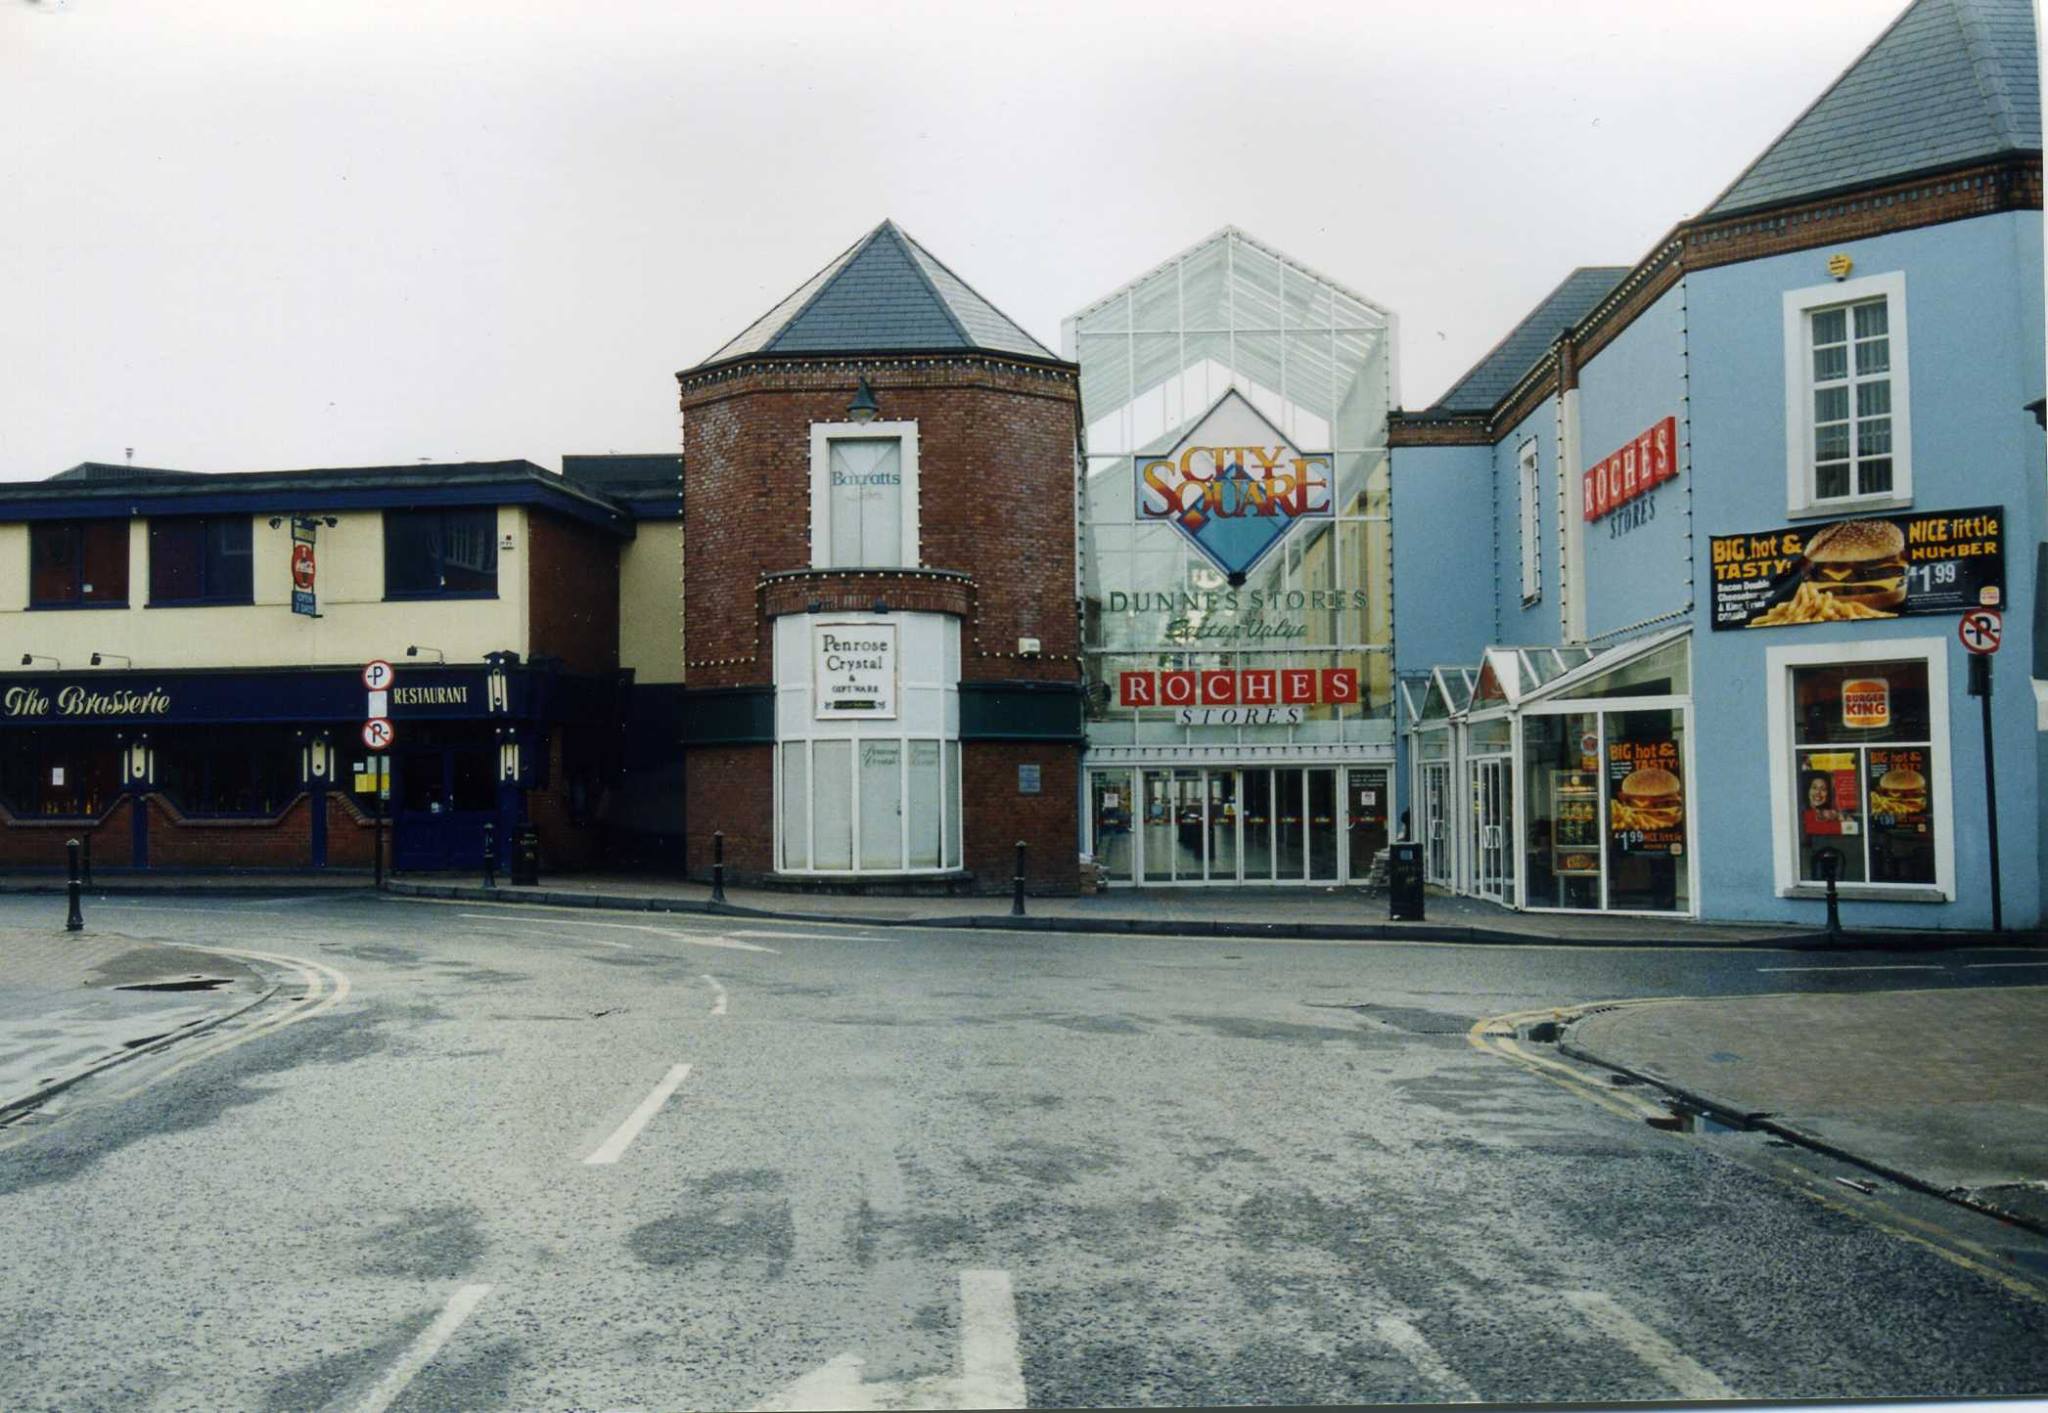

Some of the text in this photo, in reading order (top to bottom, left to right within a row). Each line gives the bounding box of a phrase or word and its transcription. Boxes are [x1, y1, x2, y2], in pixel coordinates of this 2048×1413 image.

[1180, 446, 1286, 481] CITY
[1585, 429, 1667, 513] ROCHES
[1143, 457, 1331, 518] SQUARE
[1609, 495, 1656, 540] STORES
[1908, 516, 1998, 543] NICE little
[1712, 534, 1802, 563] BIG hot &
[1912, 542, 1997, 560] NUMBER
[1250, 590, 1368, 610] STORES
[1246, 618, 1308, 640] Value
[823, 634, 888, 652] Penrose
[827, 655, 882, 672] Crystal
[393, 687, 468, 704] RESTAURANT
[1128, 674, 1350, 701] ROCHES
[1845, 694, 1885, 702] BURGER
[4, 685, 170, 716] The Brasserie
[1846, 703, 1886, 715] KING
[1181, 709, 1298, 724] STORES
[1610, 743, 1677, 761] BIG hot &
